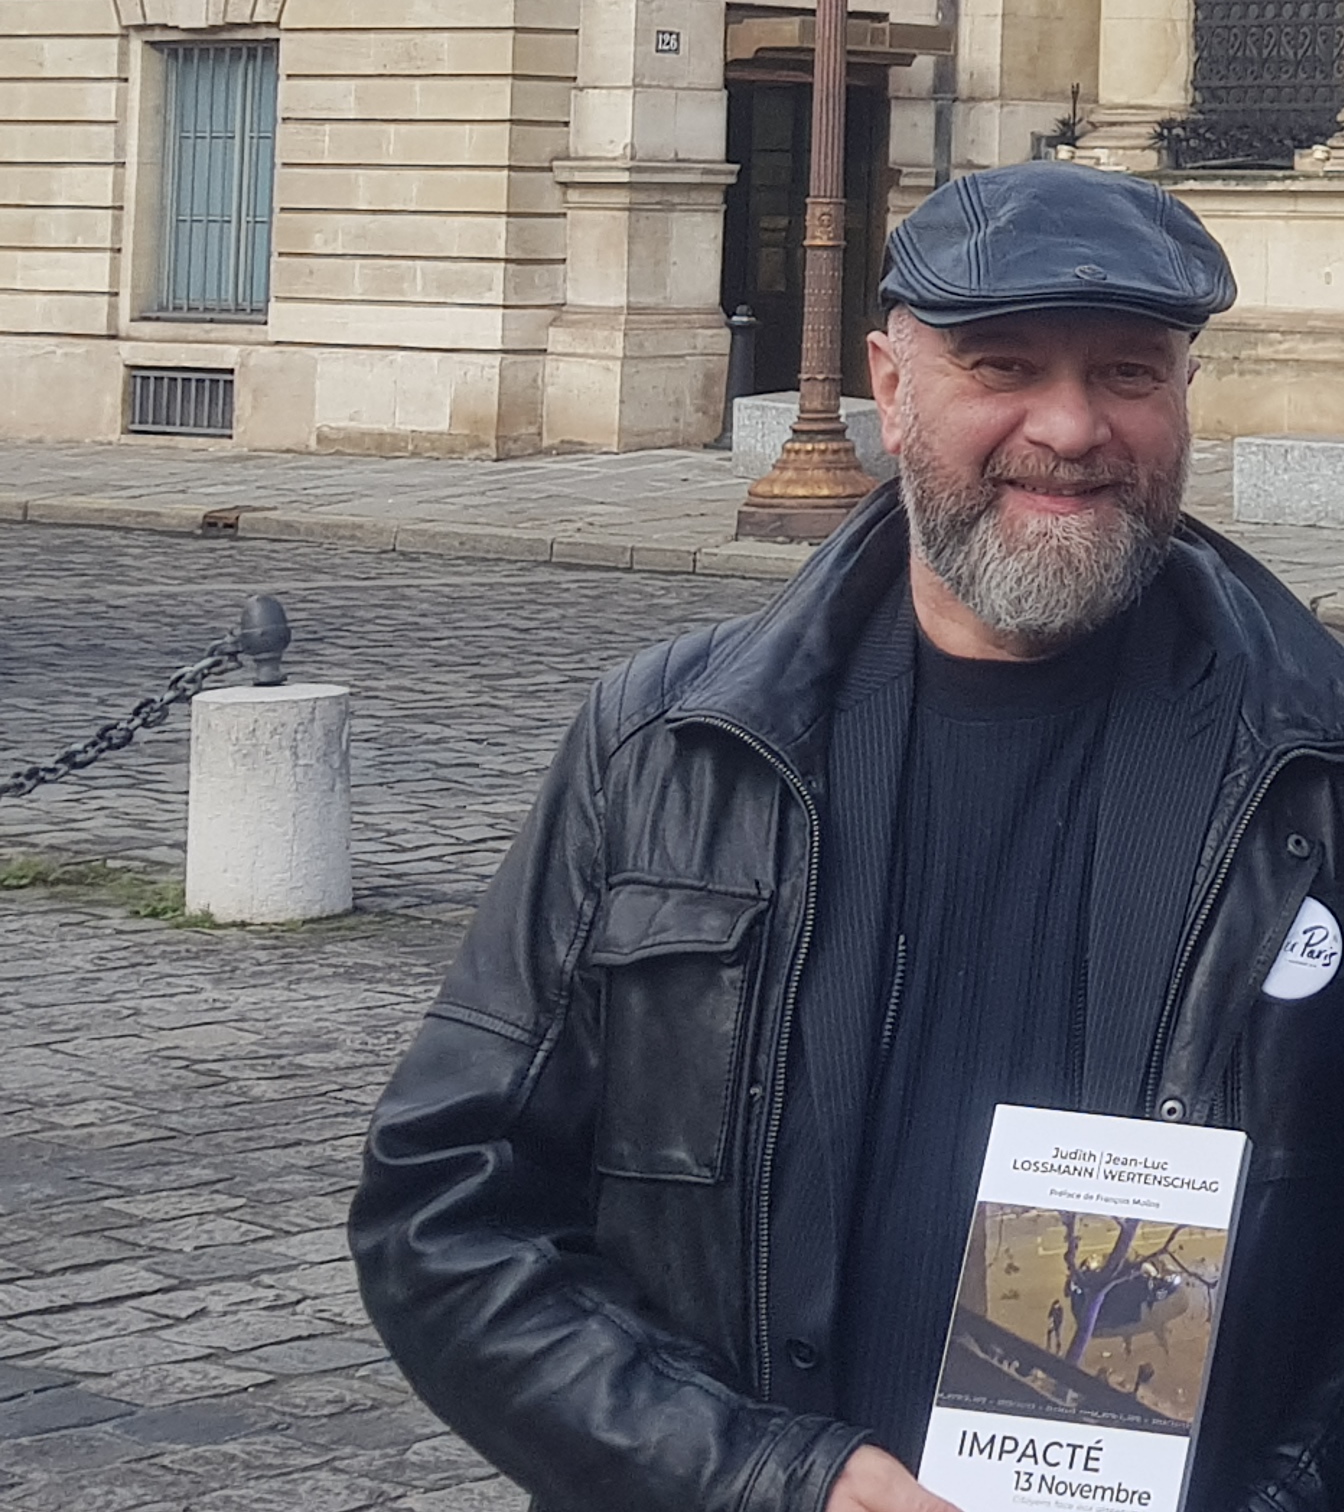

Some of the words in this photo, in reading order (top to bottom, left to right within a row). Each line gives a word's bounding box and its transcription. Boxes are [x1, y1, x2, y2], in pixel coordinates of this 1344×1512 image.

[658, 32, 678, 50] 126
[1300, 925, 1338, 967] Paris
[1012, 1158, 1095, 1179] LOSSMANN
[1103, 1170, 1219, 1192] WERTENSCHLAG
[1052, 1146, 1097, 1163] Judith
[1104, 1152, 1169, 1171] Jean-Luc
[957, 1430, 1103, 1473] IMPACTÉ
[1014, 1470, 1033, 1492] 13
[1037, 1474, 1152, 1506] Novembre
